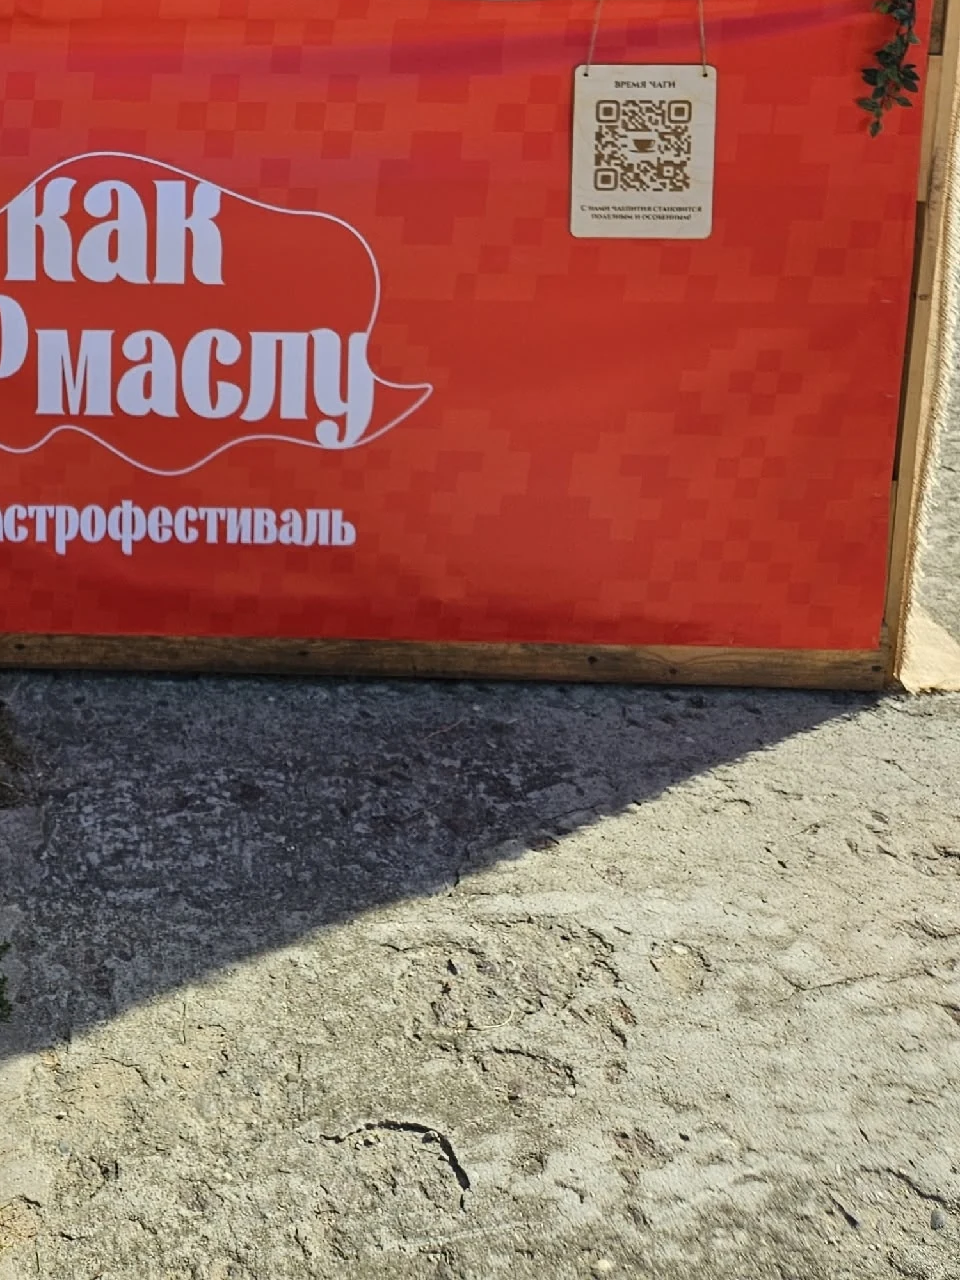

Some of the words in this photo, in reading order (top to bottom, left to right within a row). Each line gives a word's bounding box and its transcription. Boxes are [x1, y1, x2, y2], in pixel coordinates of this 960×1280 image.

[614, 81, 647, 89] ВРЕМЯ
[649, 81, 676, 89] ЧАГИ
[35, 328, 375, 449] маслу
